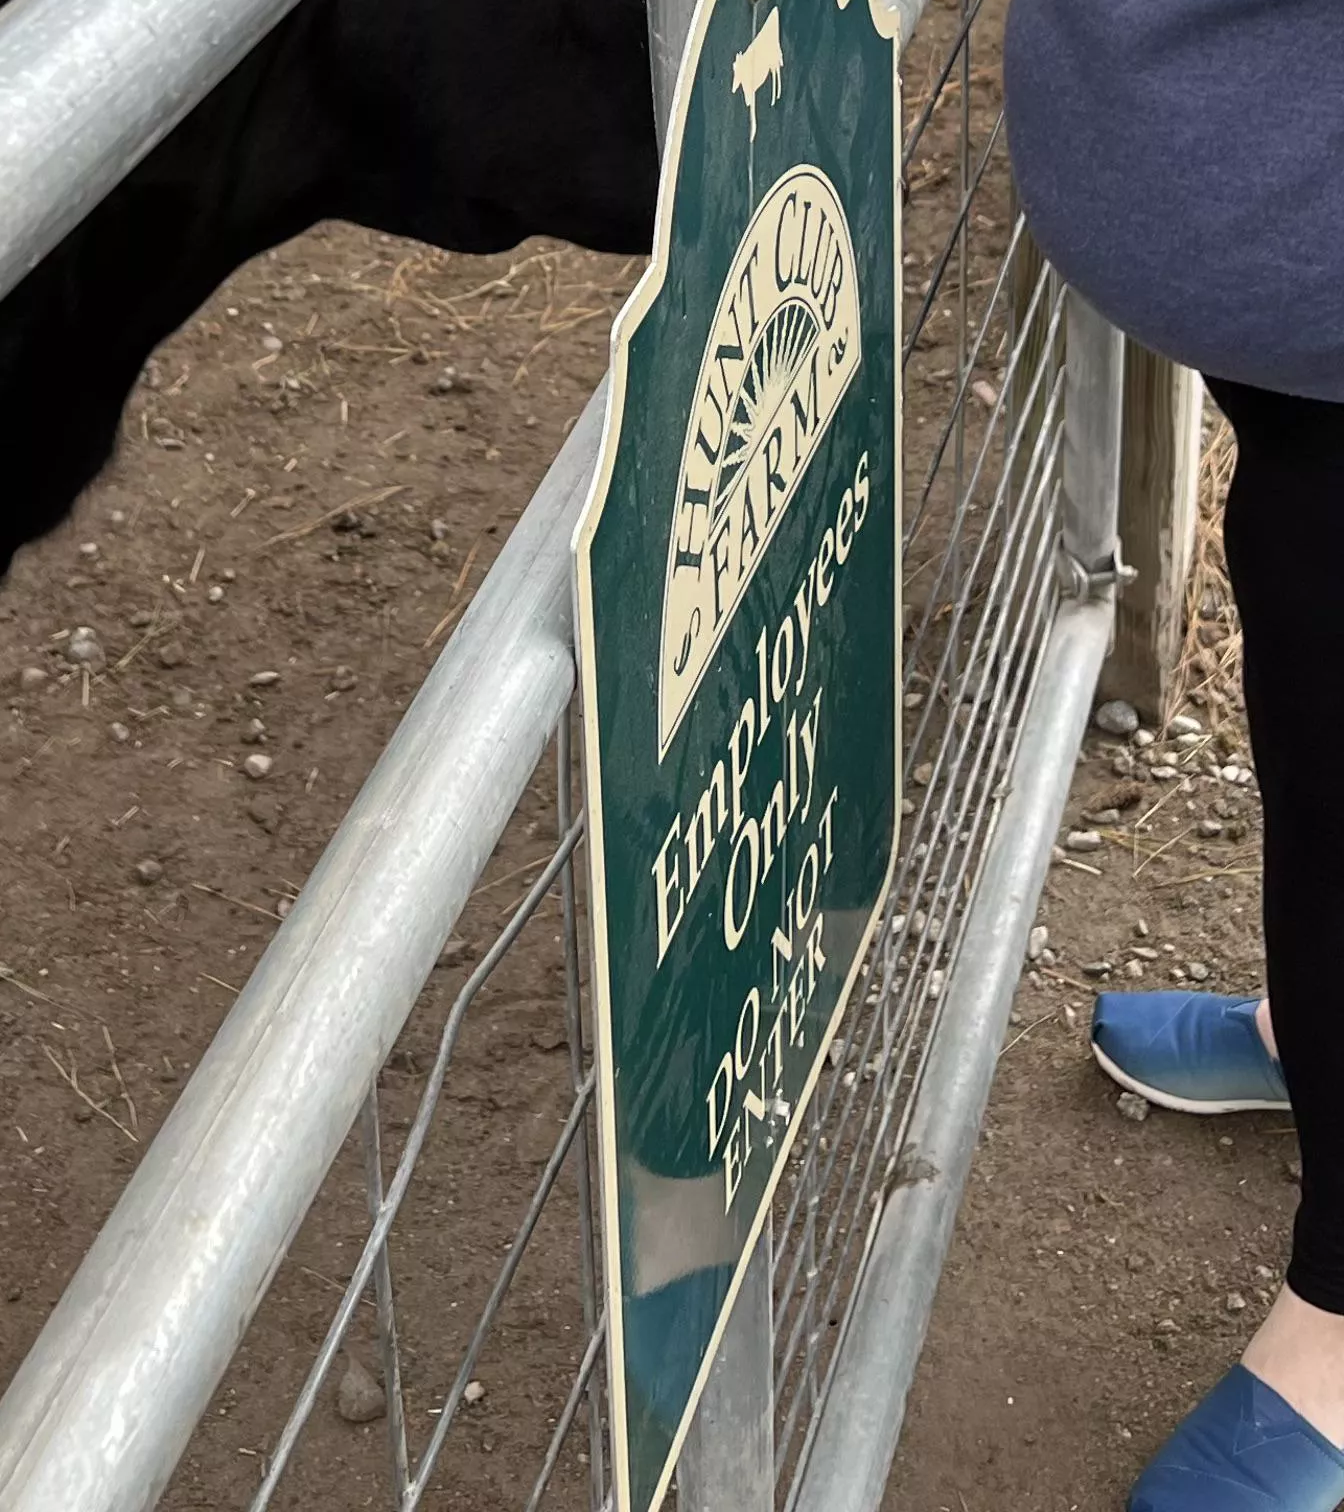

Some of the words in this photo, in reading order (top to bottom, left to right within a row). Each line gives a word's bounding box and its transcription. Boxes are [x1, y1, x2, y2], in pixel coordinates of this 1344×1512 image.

[673, 243, 760, 582] HUNT
[775, 190, 844, 331] CLUB
[708, 345, 822, 631] FARM
[652, 450, 870, 969] Employees
[723, 687, 822, 952] Only
[706, 987, 760, 1161] DO
[770, 786, 838, 1004] NOT
[723, 912, 826, 1216] ENTER
